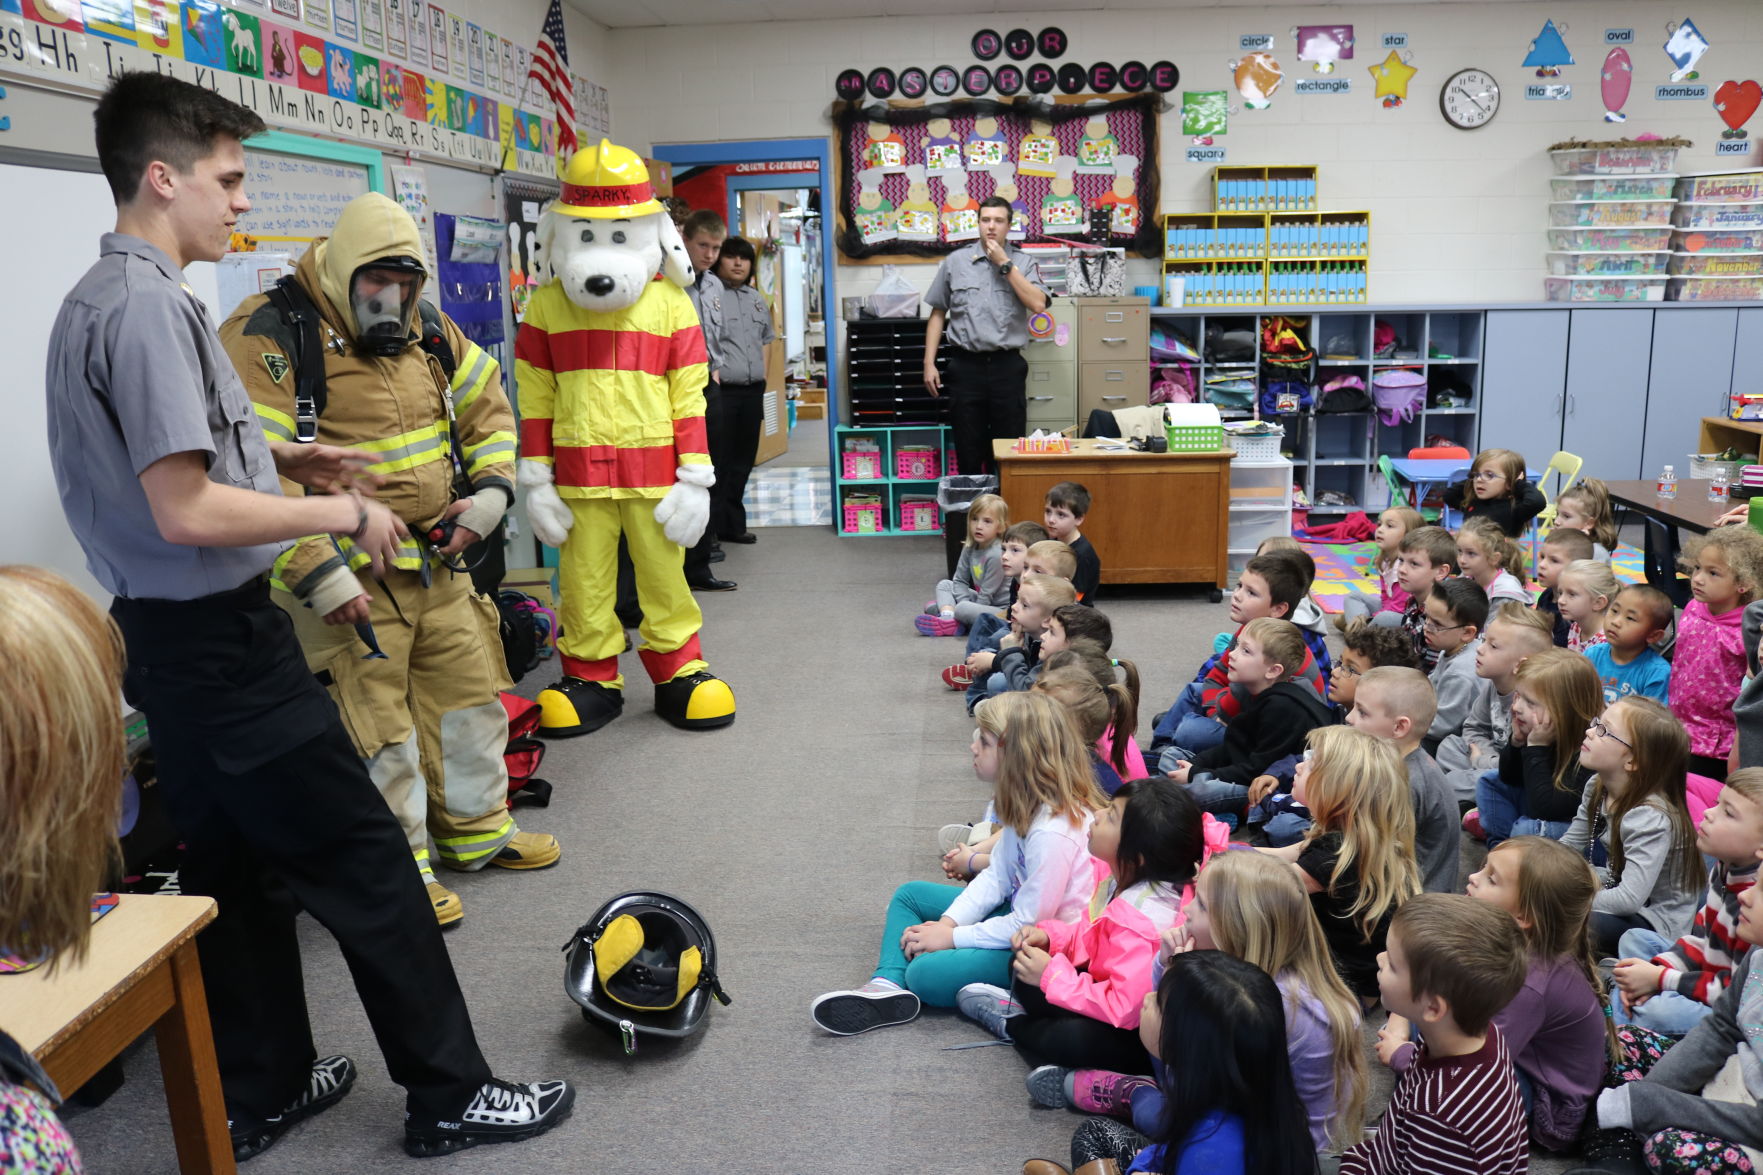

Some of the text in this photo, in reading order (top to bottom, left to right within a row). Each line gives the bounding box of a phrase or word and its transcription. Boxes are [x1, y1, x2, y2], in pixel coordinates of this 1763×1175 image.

[1385, 36, 1405, 46] star
[1607, 30, 1631, 41] oval
[977, 33, 1061, 55] OUR
[1297, 80, 1349, 93] rectangle
[1658, 86, 1705, 97] rhombus
[1719, 143, 1748, 153] heart
[1695, 180, 1753, 198] February
[1716, 212, 1763, 226] January
[1706, 259, 1760, 273] November
[437, 1120, 461, 1130] REAX
